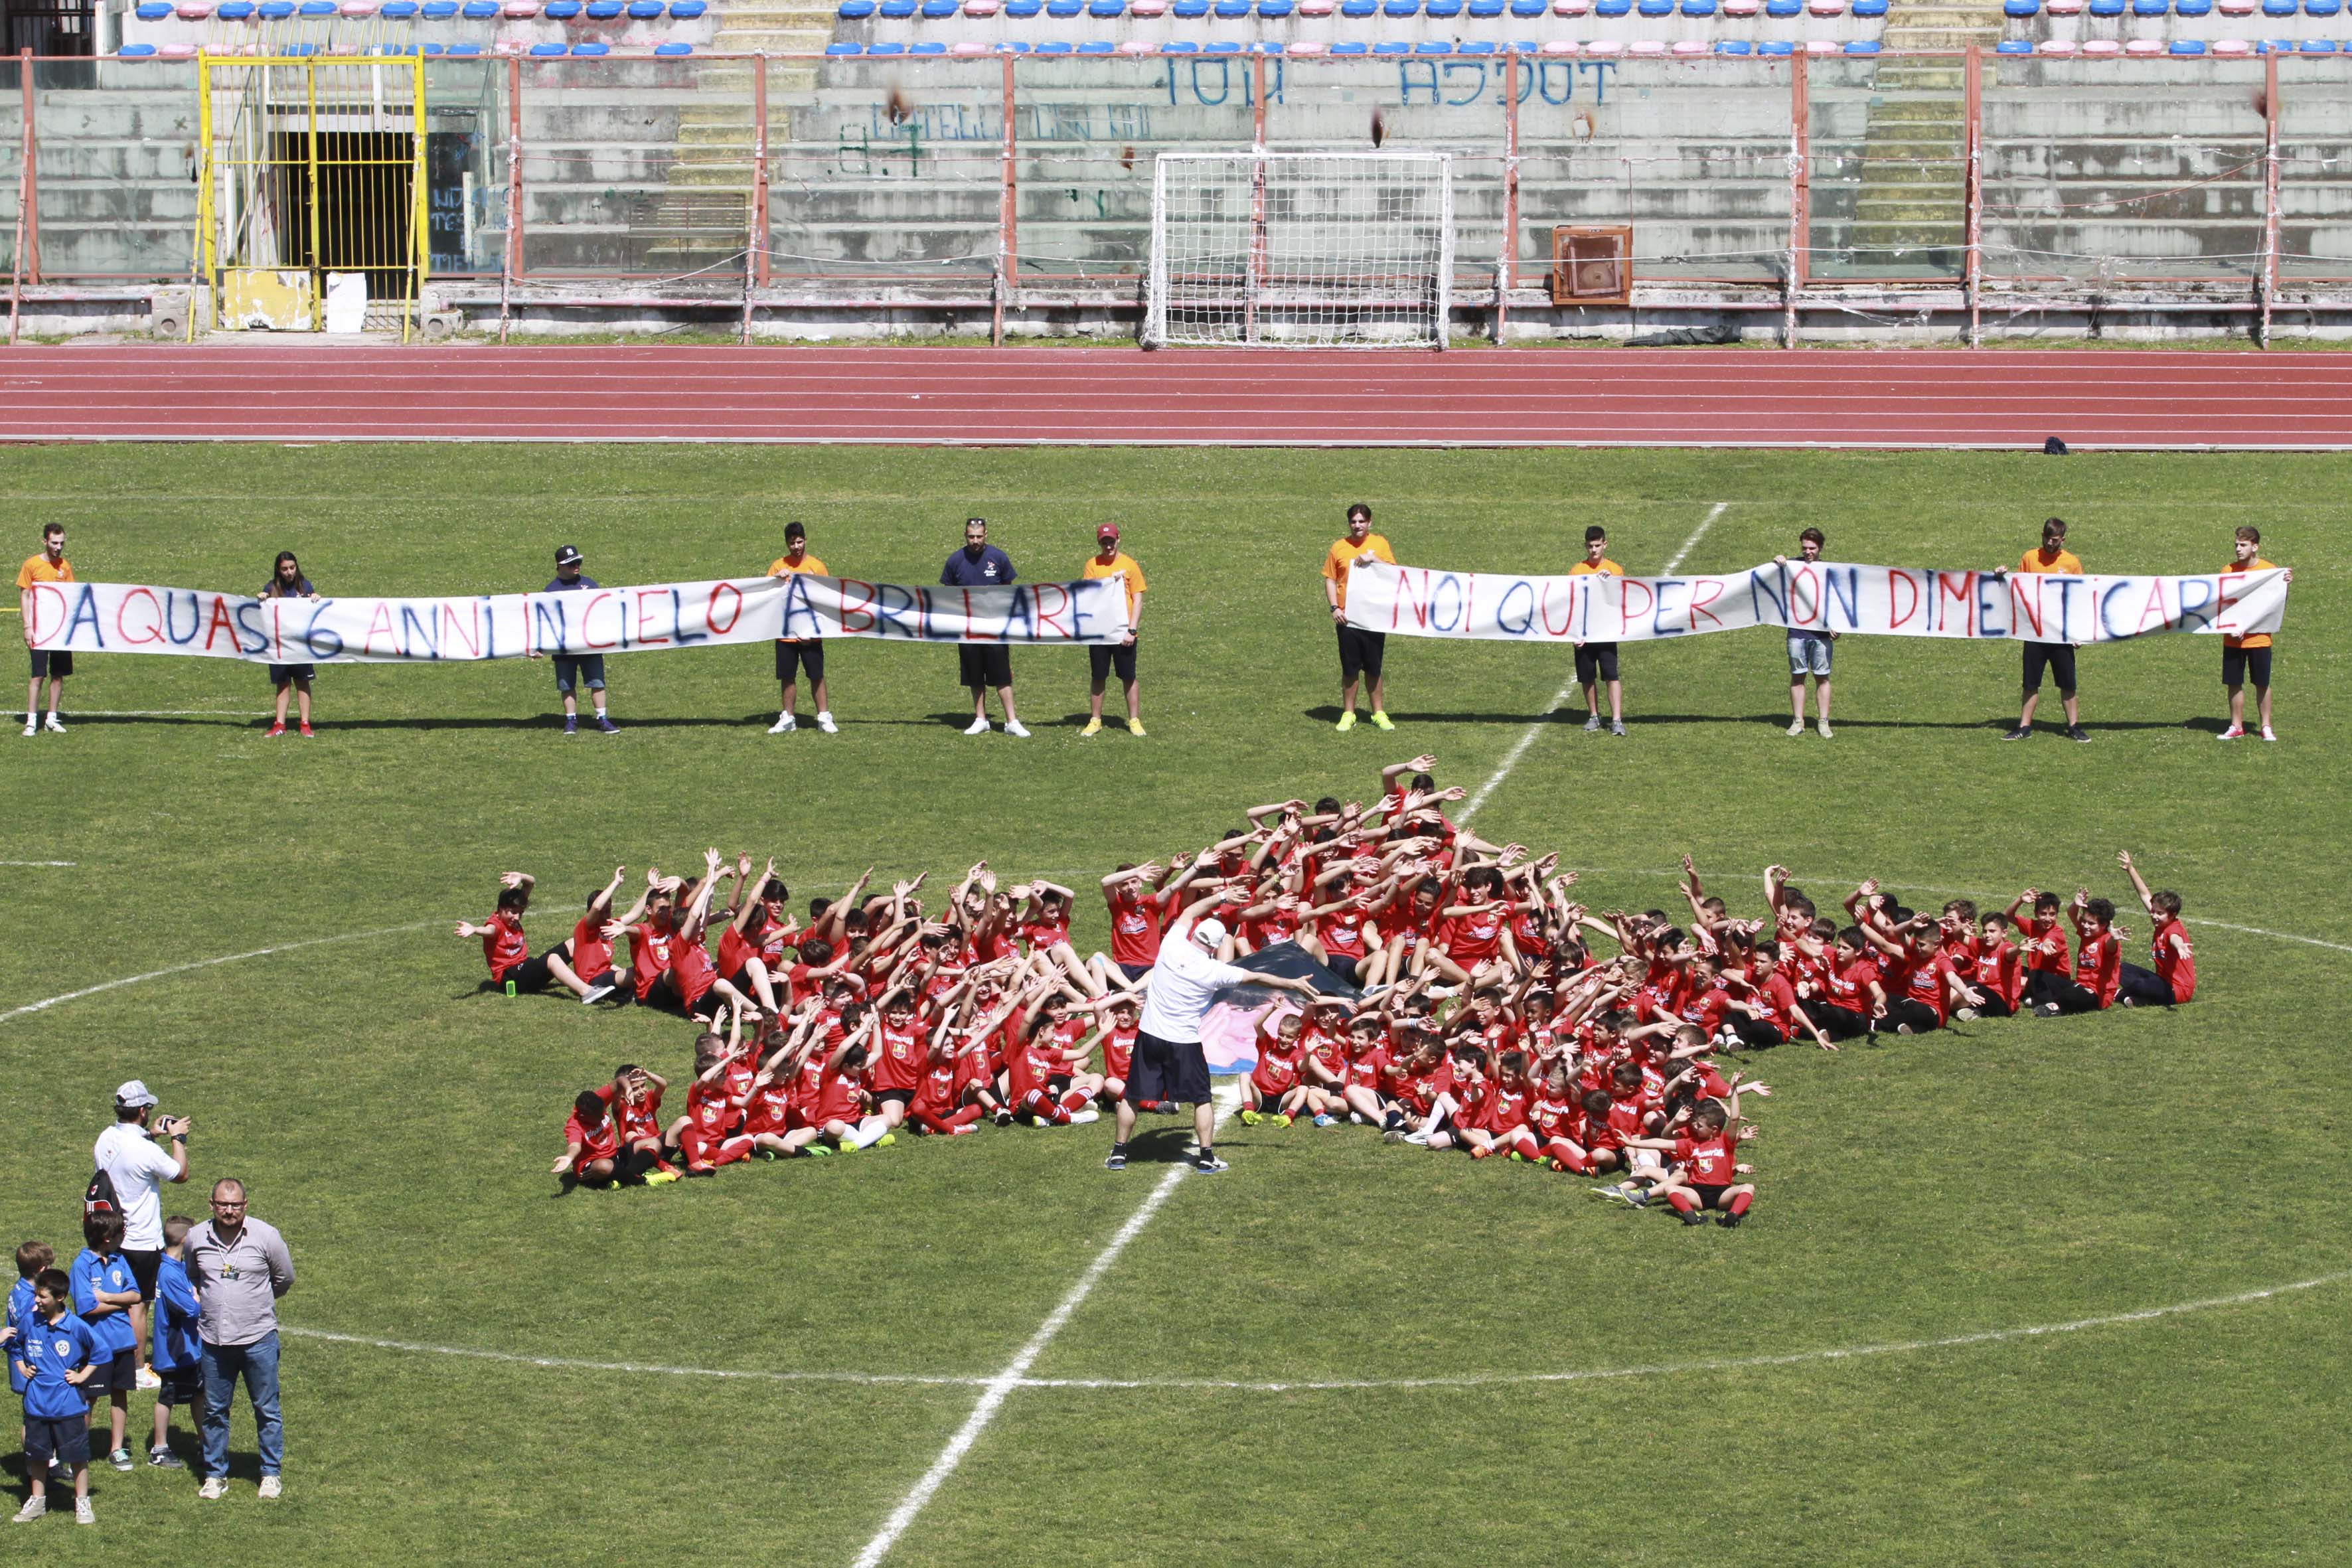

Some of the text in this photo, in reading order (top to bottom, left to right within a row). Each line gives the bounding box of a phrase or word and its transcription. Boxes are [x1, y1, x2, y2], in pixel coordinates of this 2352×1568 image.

[31, 584, 104, 649] DA
[118, 588, 281, 659] QUASI
[305, 600, 343, 659] 6
[364, 595, 494, 660] ANNI
[583, 582, 742, 649] CIELO
[781, 573, 822, 637] A
[839, 578, 1105, 642] BRILLARE
[1392, 564, 2246, 643] NOI QUI PER NON DIMENTICARE
